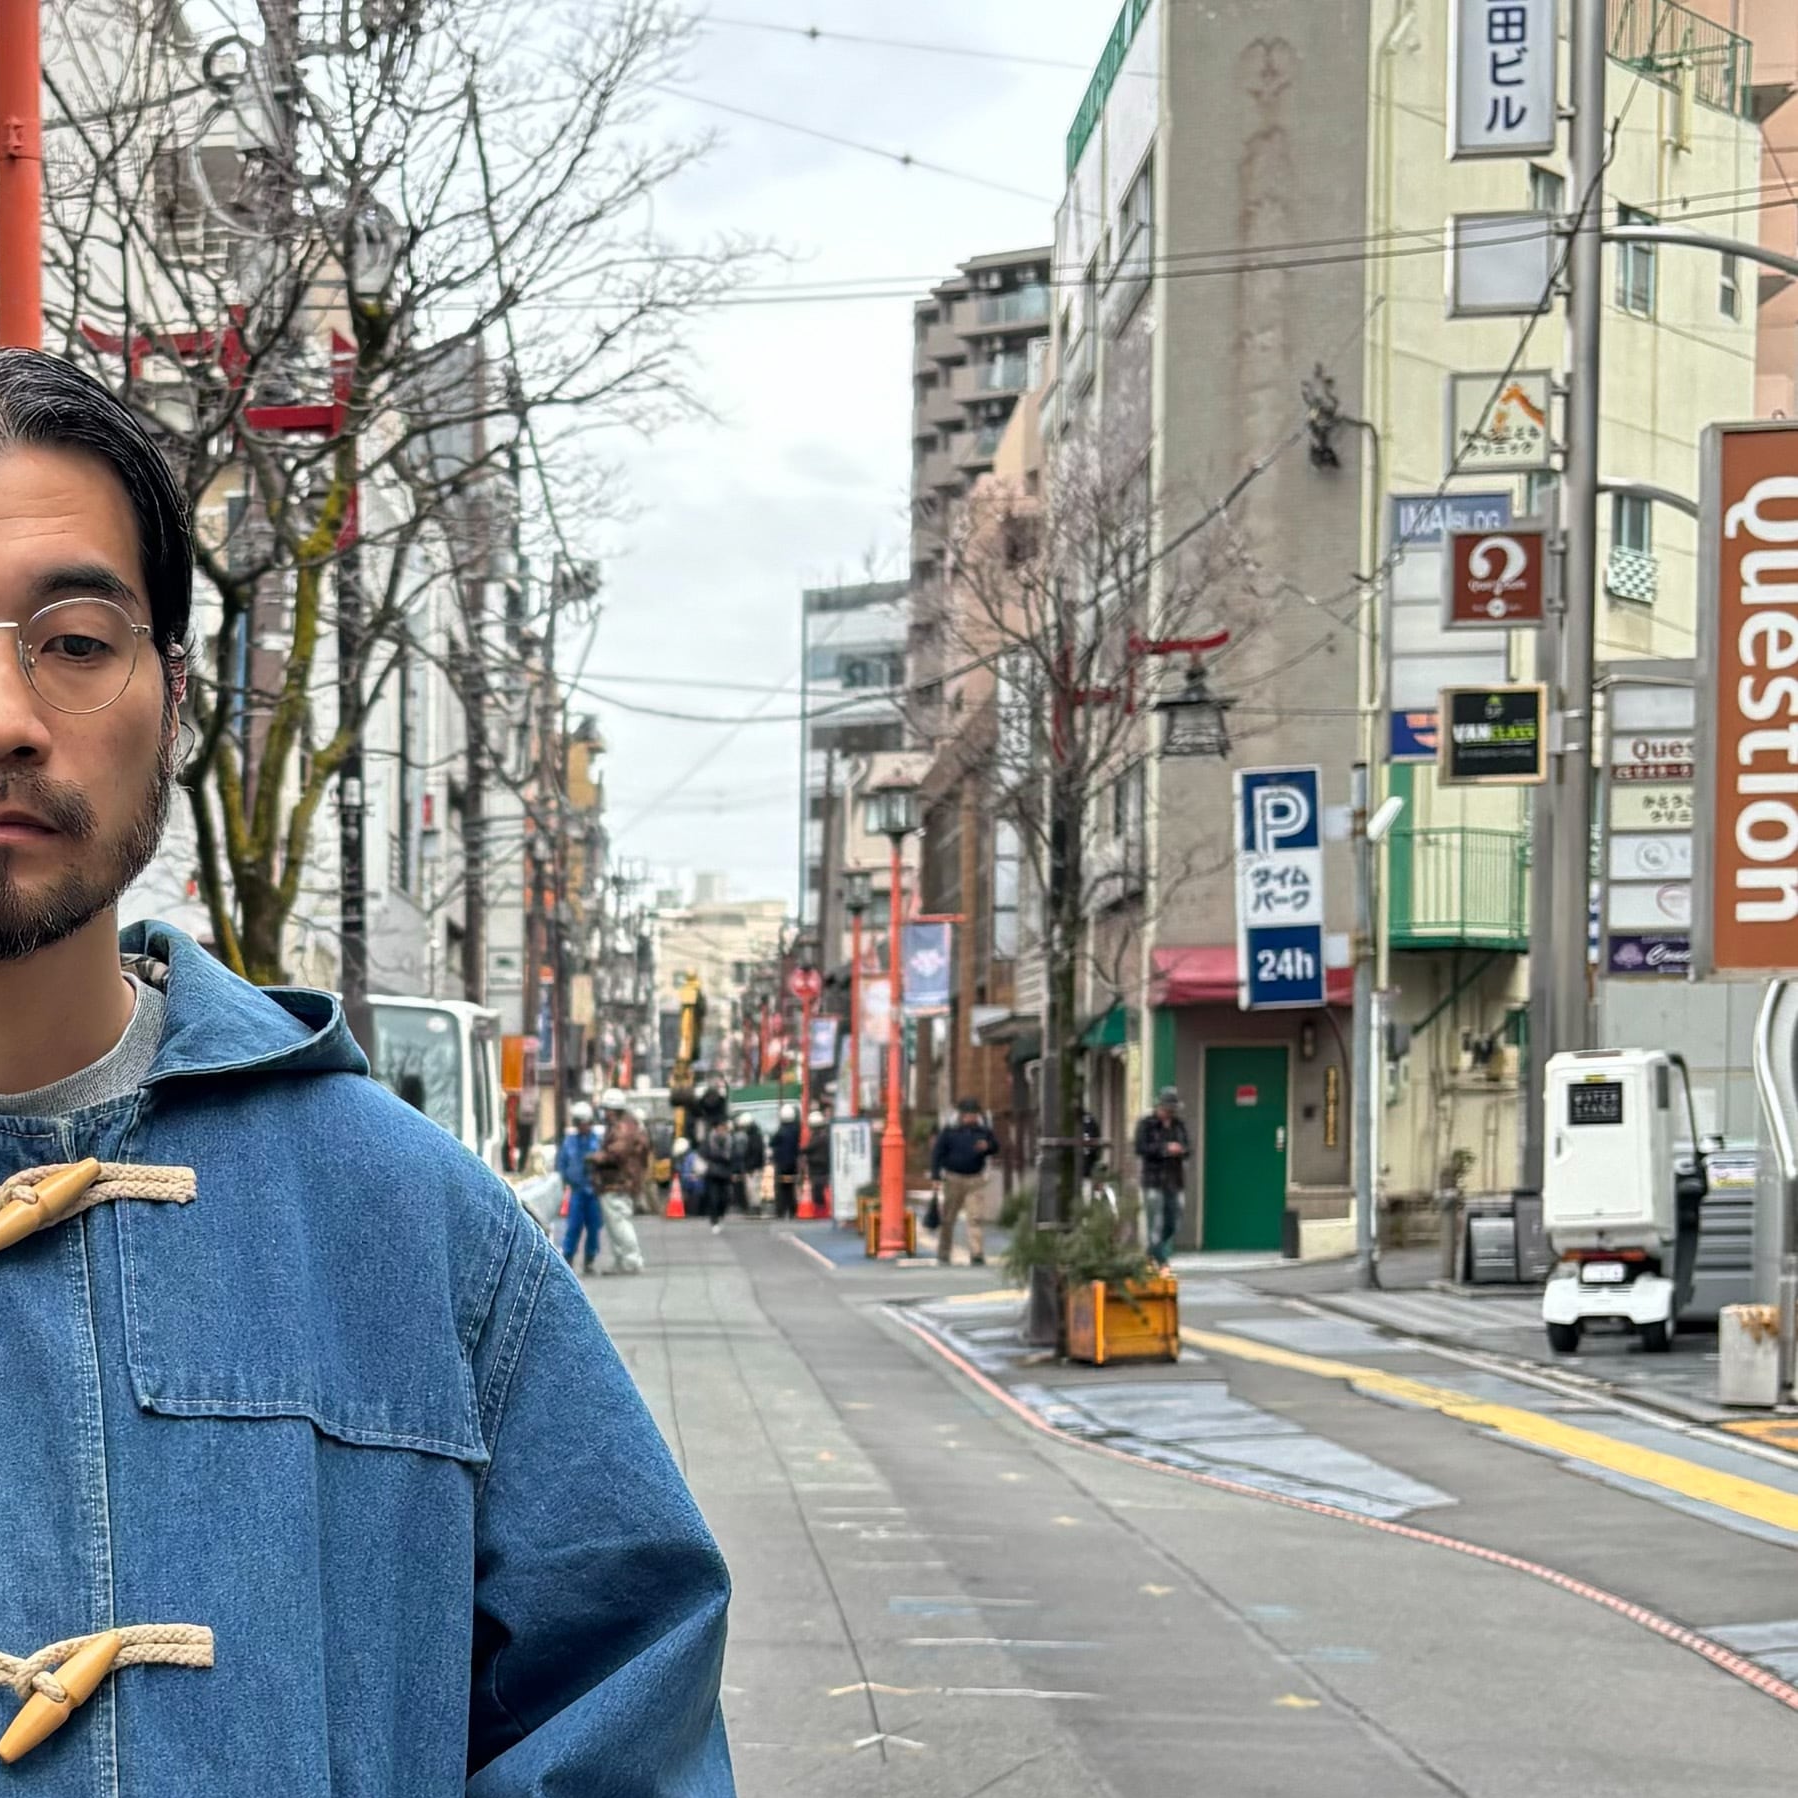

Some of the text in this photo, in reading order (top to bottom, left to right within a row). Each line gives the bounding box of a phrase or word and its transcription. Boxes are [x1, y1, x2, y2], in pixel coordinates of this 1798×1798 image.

[1486, 0, 1528, 132] 田ビル
[1724, 475, 1798, 923] Question
[1251, 865, 1311, 887] タイム
[1252, 890, 1311, 912] パーク
[1257, 947, 1315, 982] 24h
